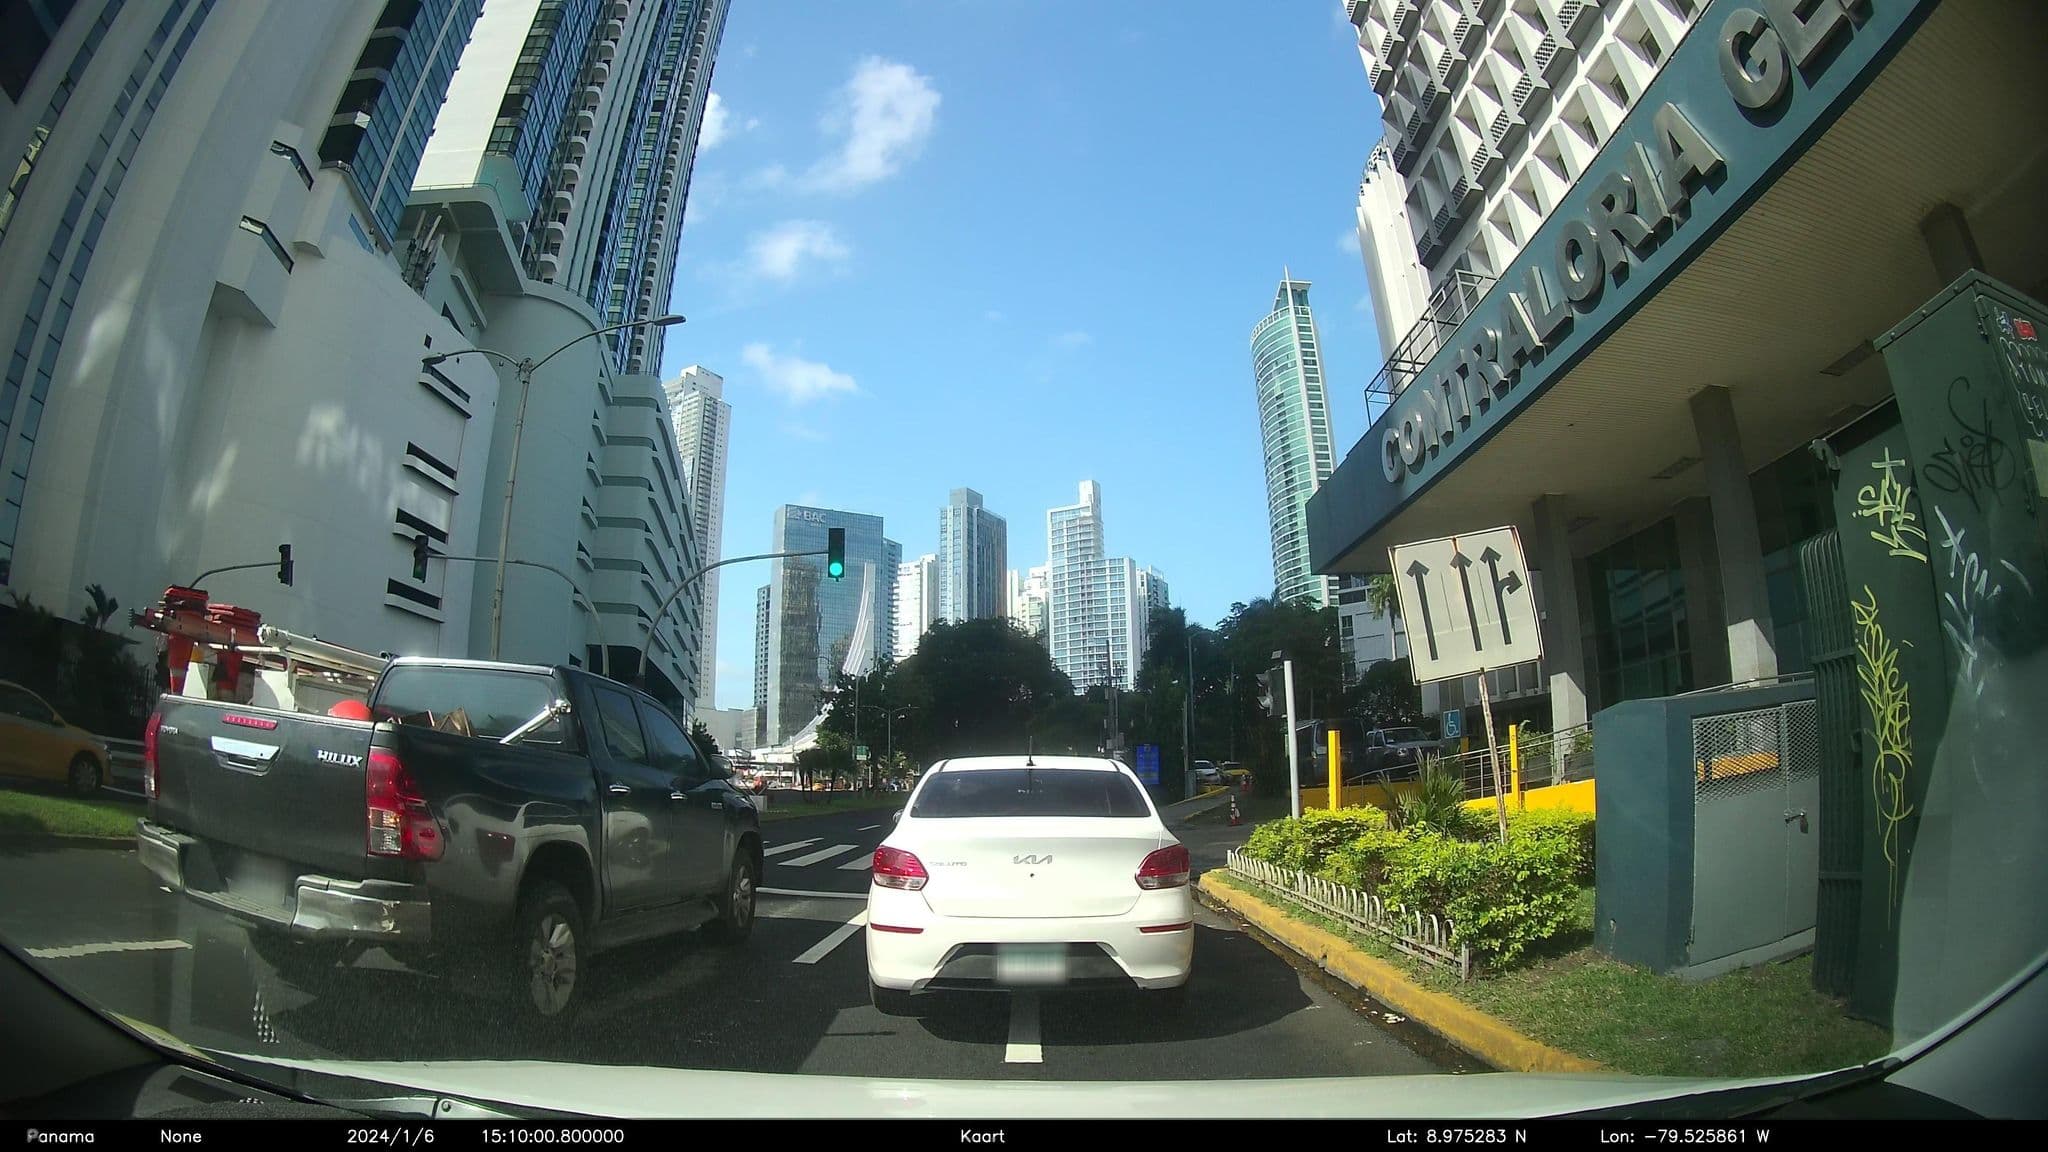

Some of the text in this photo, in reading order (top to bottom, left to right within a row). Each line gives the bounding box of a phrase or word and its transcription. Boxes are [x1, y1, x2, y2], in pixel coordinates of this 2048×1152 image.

[1381, 101, 1727, 483] CONTRALORIA
[1718, 0, 1874, 109] GE
[803, 510, 827, 523] BAC
[317, 749, 364, 768] HILUX
